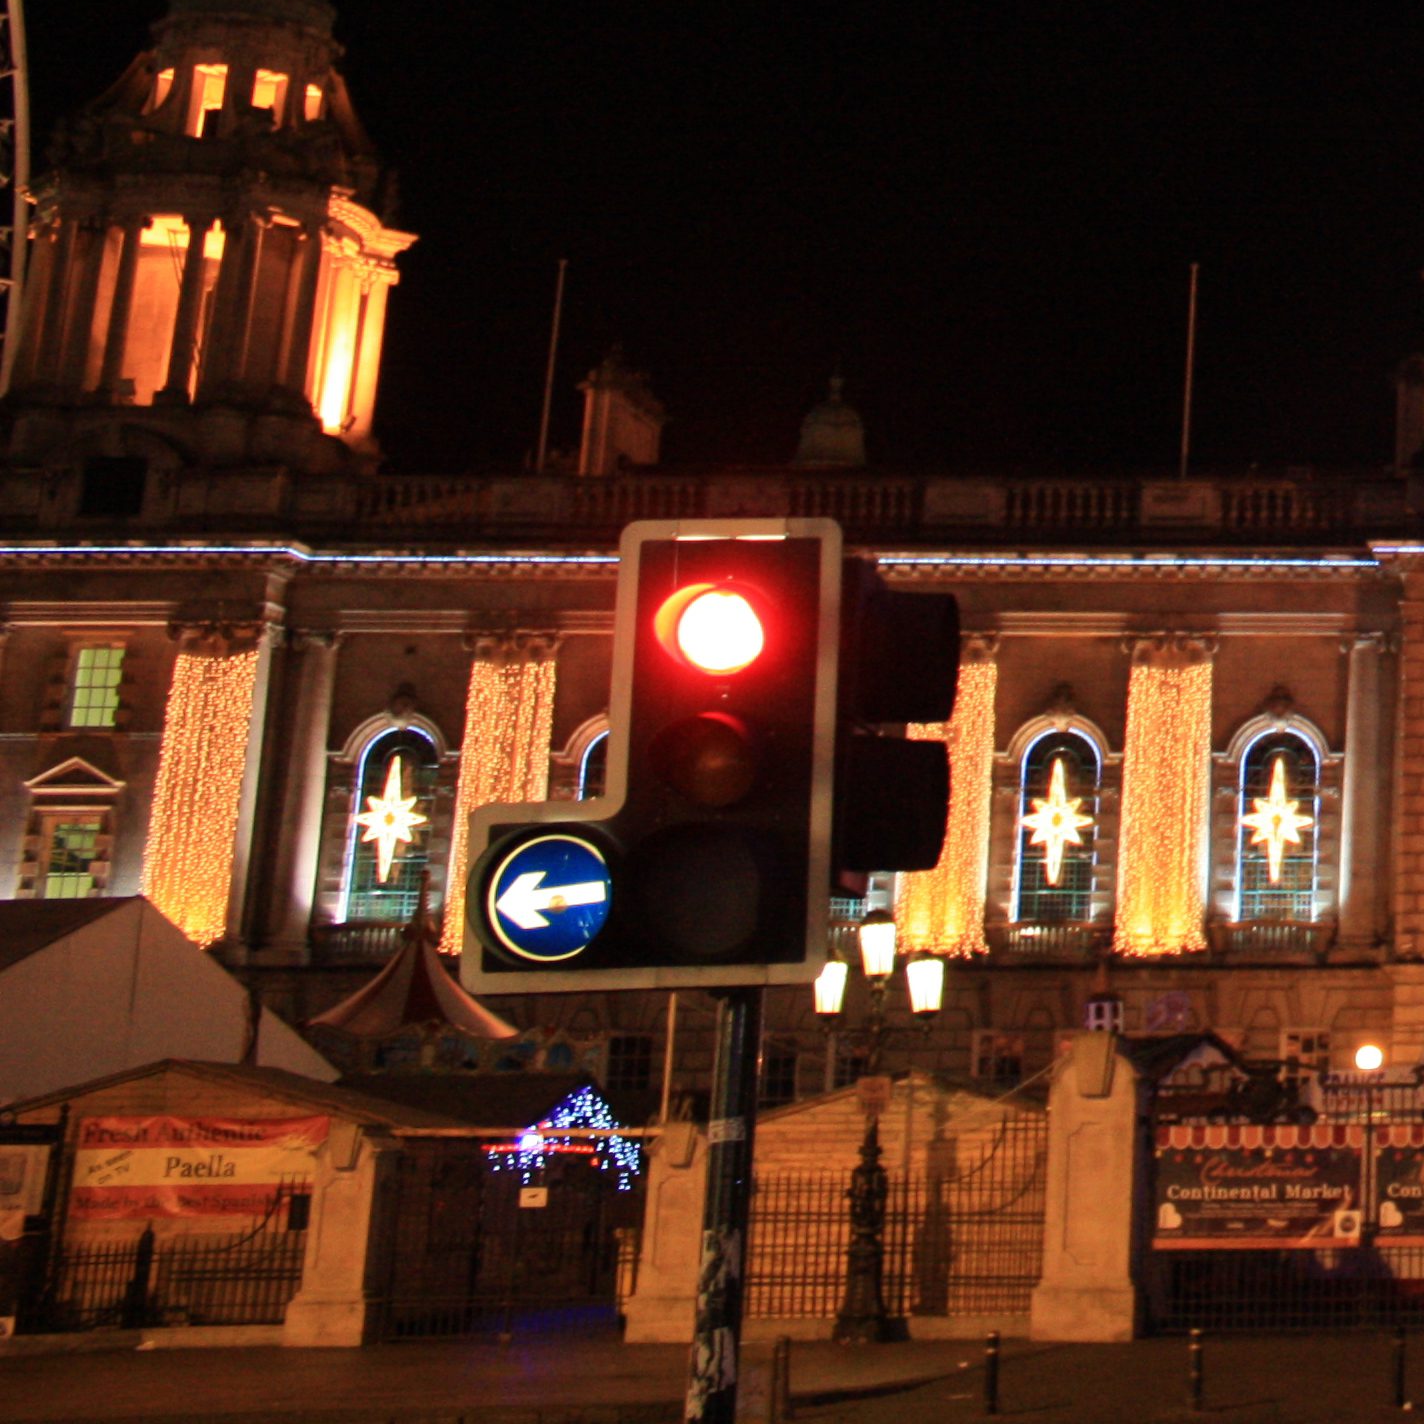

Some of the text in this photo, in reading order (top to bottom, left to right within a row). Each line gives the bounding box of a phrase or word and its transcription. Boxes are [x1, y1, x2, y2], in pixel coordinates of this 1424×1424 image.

[163, 1154, 237, 1178] Paella
[1166, 1182, 1353, 1201] Continental Market
